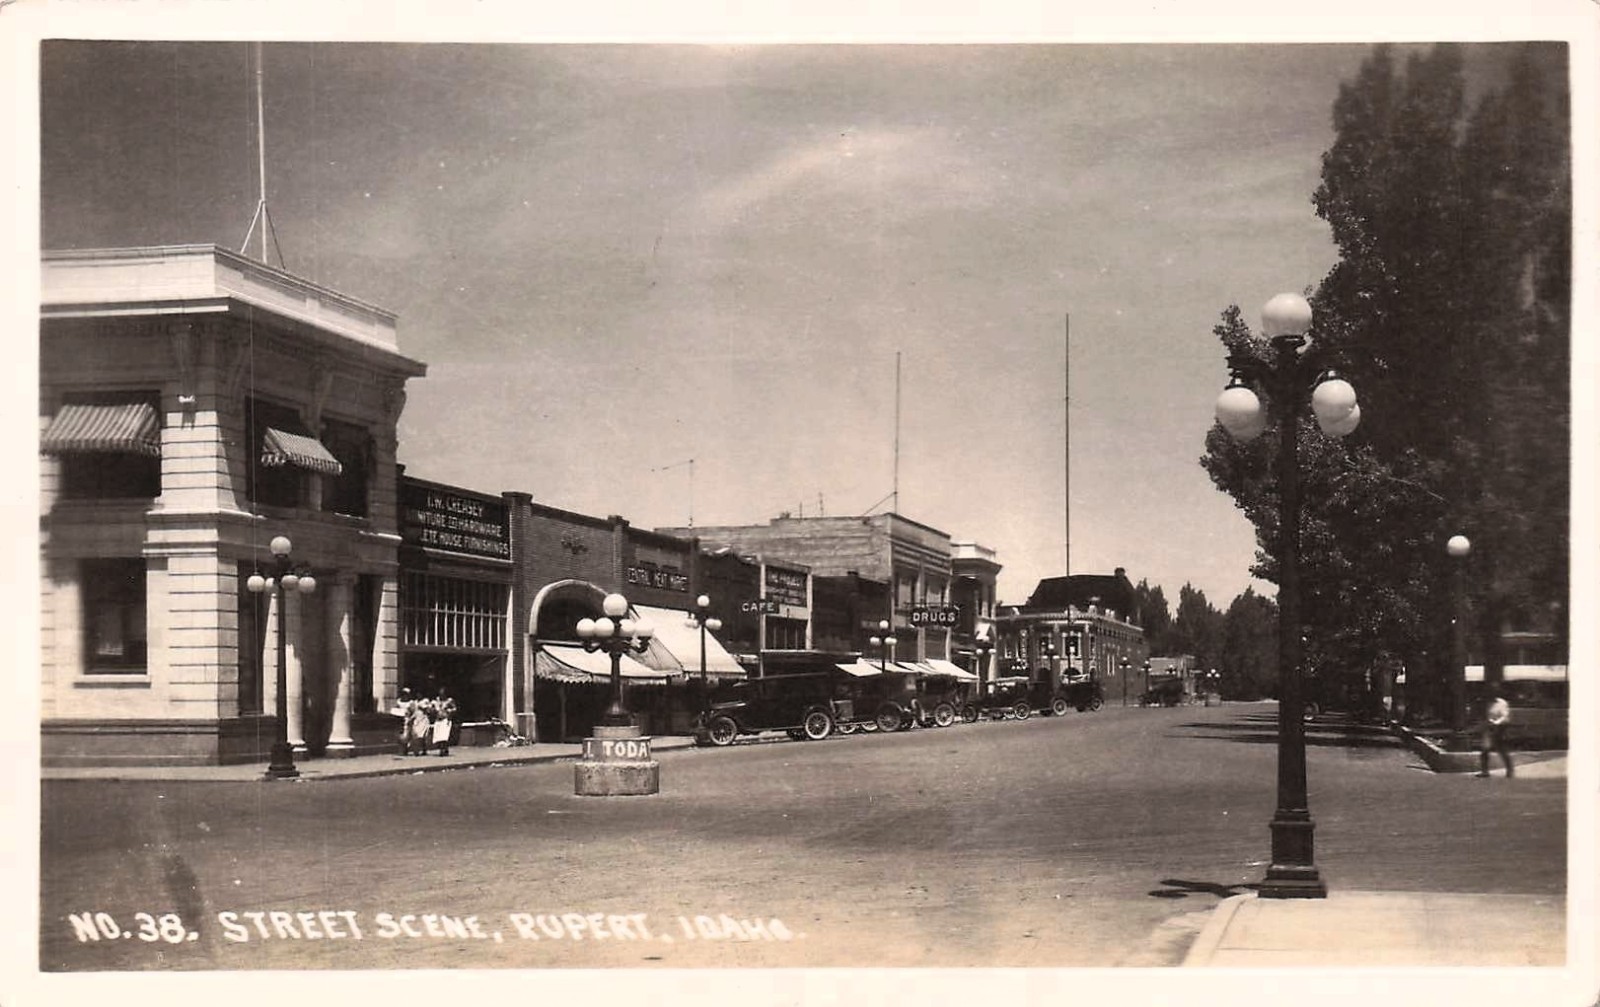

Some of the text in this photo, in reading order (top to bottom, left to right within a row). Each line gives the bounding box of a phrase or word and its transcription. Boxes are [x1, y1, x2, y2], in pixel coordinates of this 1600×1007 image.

[459, 518, 502, 538] HARDWARE
[439, 532, 463, 548] HOUSE
[742, 602, 775, 612] CAFE
[912, 612, 955, 622] DRUGS
